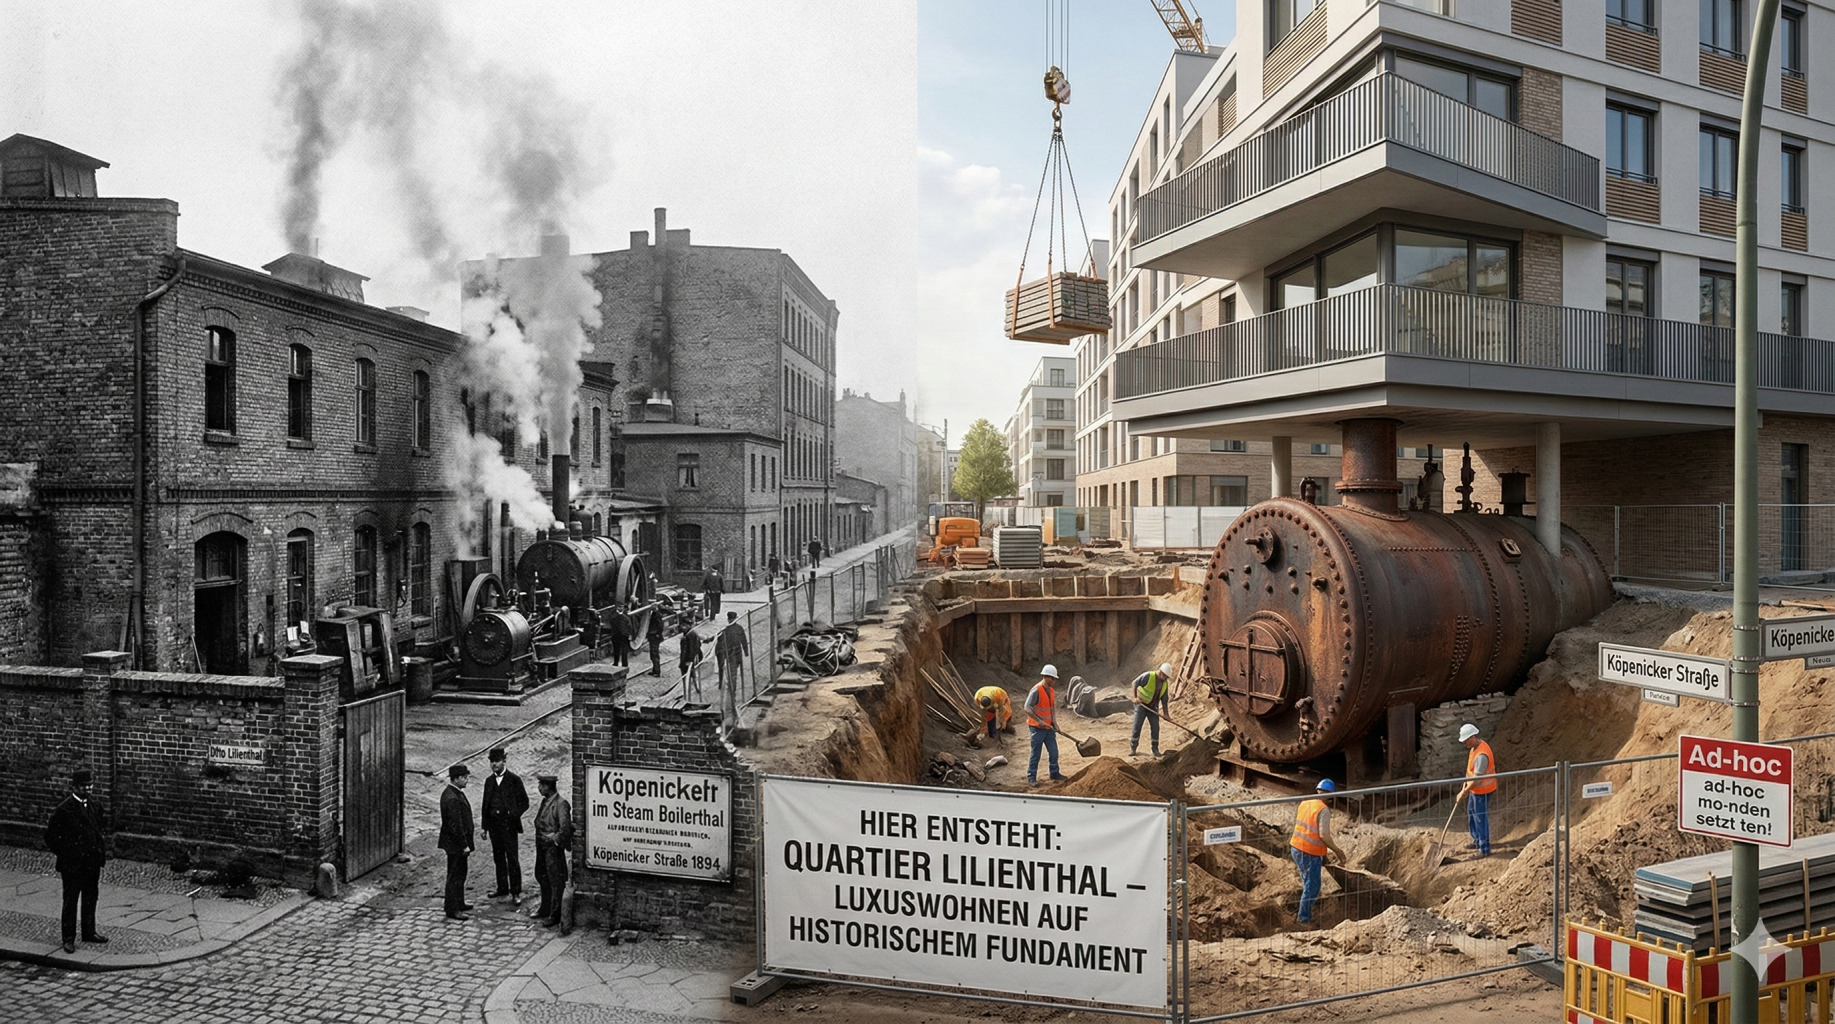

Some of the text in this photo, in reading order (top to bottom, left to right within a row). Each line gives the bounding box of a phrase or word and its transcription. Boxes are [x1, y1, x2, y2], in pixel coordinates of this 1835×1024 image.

[1607, 653, 1719, 690] Köpenicker Straße
[1688, 744, 1782, 776] Ad-hoc
[1704, 780, 1765, 799] ad-hoc
[592, 800, 724, 827] im Steam Boilerthal
[1698, 797, 1770, 818] mo-nden
[860, 809, 1061, 850] HIER ENTSTEHT:
[1696, 814, 1772, 836] setzt ten!
[593, 846, 721, 871] Köpenicker Straße 1894
[784, 840, 931, 882] QUARTIER
[943, 854, 1117, 898] LILIENTHAL
[835, 884, 1088, 931] LUXUSWOHNEN AUF
[789, 916, 1147, 974] HISTORISCHEM FUNDAMENT
